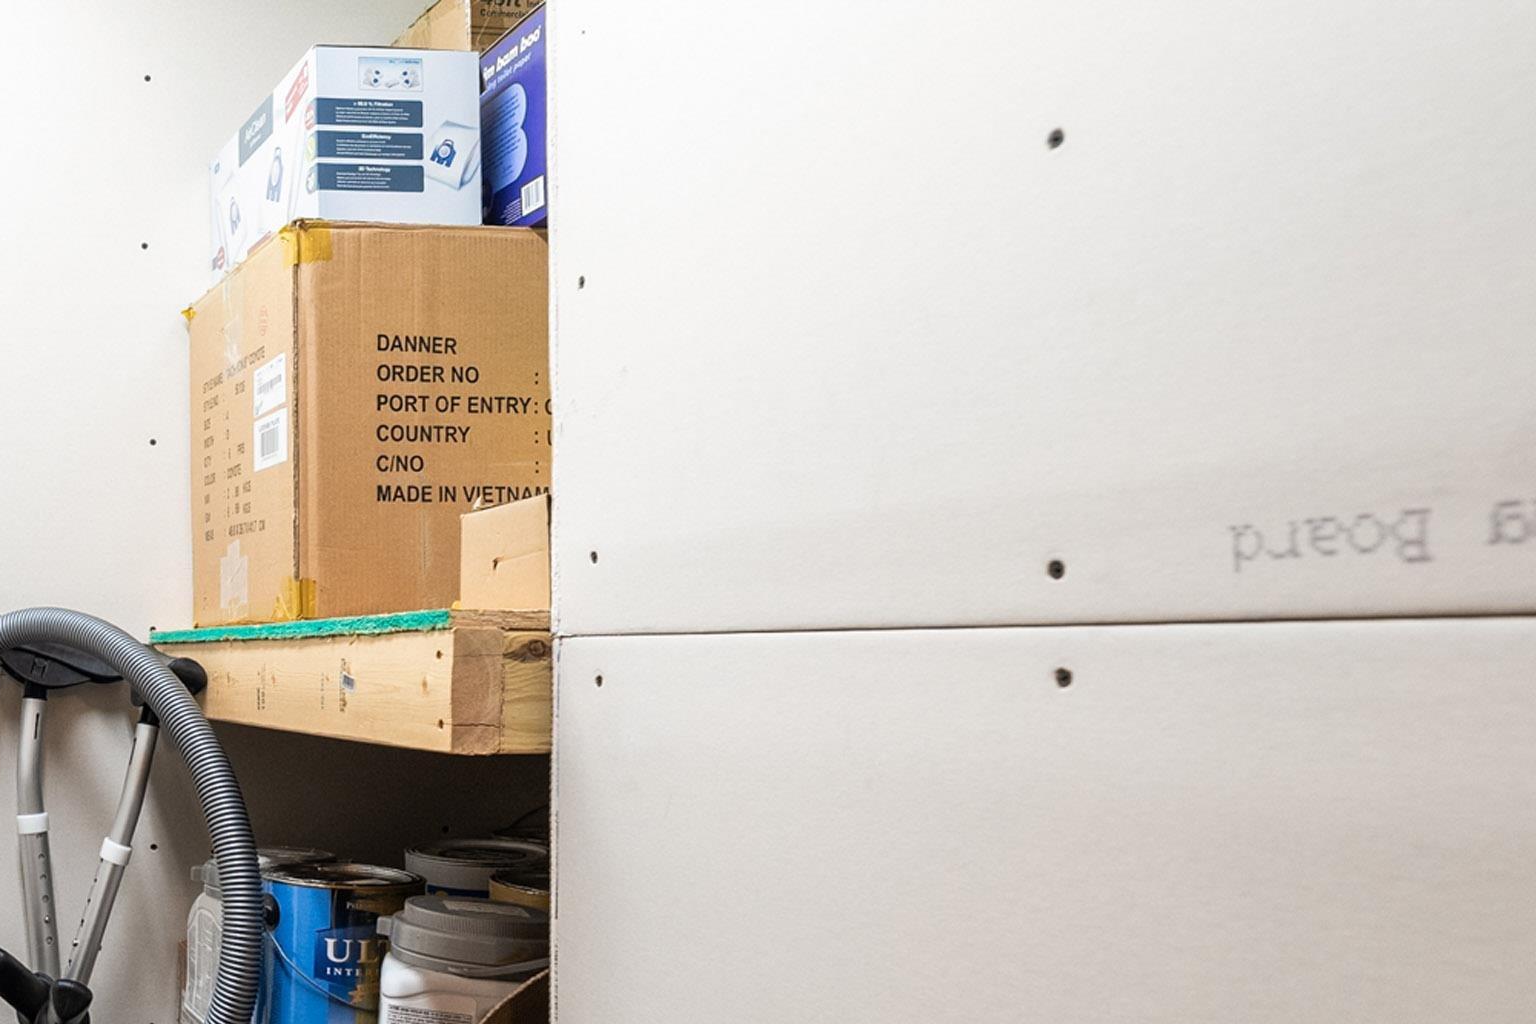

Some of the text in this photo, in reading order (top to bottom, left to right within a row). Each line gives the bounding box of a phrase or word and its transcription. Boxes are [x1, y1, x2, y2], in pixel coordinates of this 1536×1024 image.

[496, 45, 518, 72] bam
[520, 29, 540, 53] boo
[377, 334, 457, 354] DANNER
[377, 364, 479, 383] ORDER NO
[377, 394, 430, 412] PORT
[435, 395, 461, 413] OF
[376, 424, 471, 443] COUNTRY
[376, 455, 424, 472] C/NO
[377, 484, 432, 502] MADE
[439, 486, 457, 502] IN
[1228, 508, 1435, 573] Board
